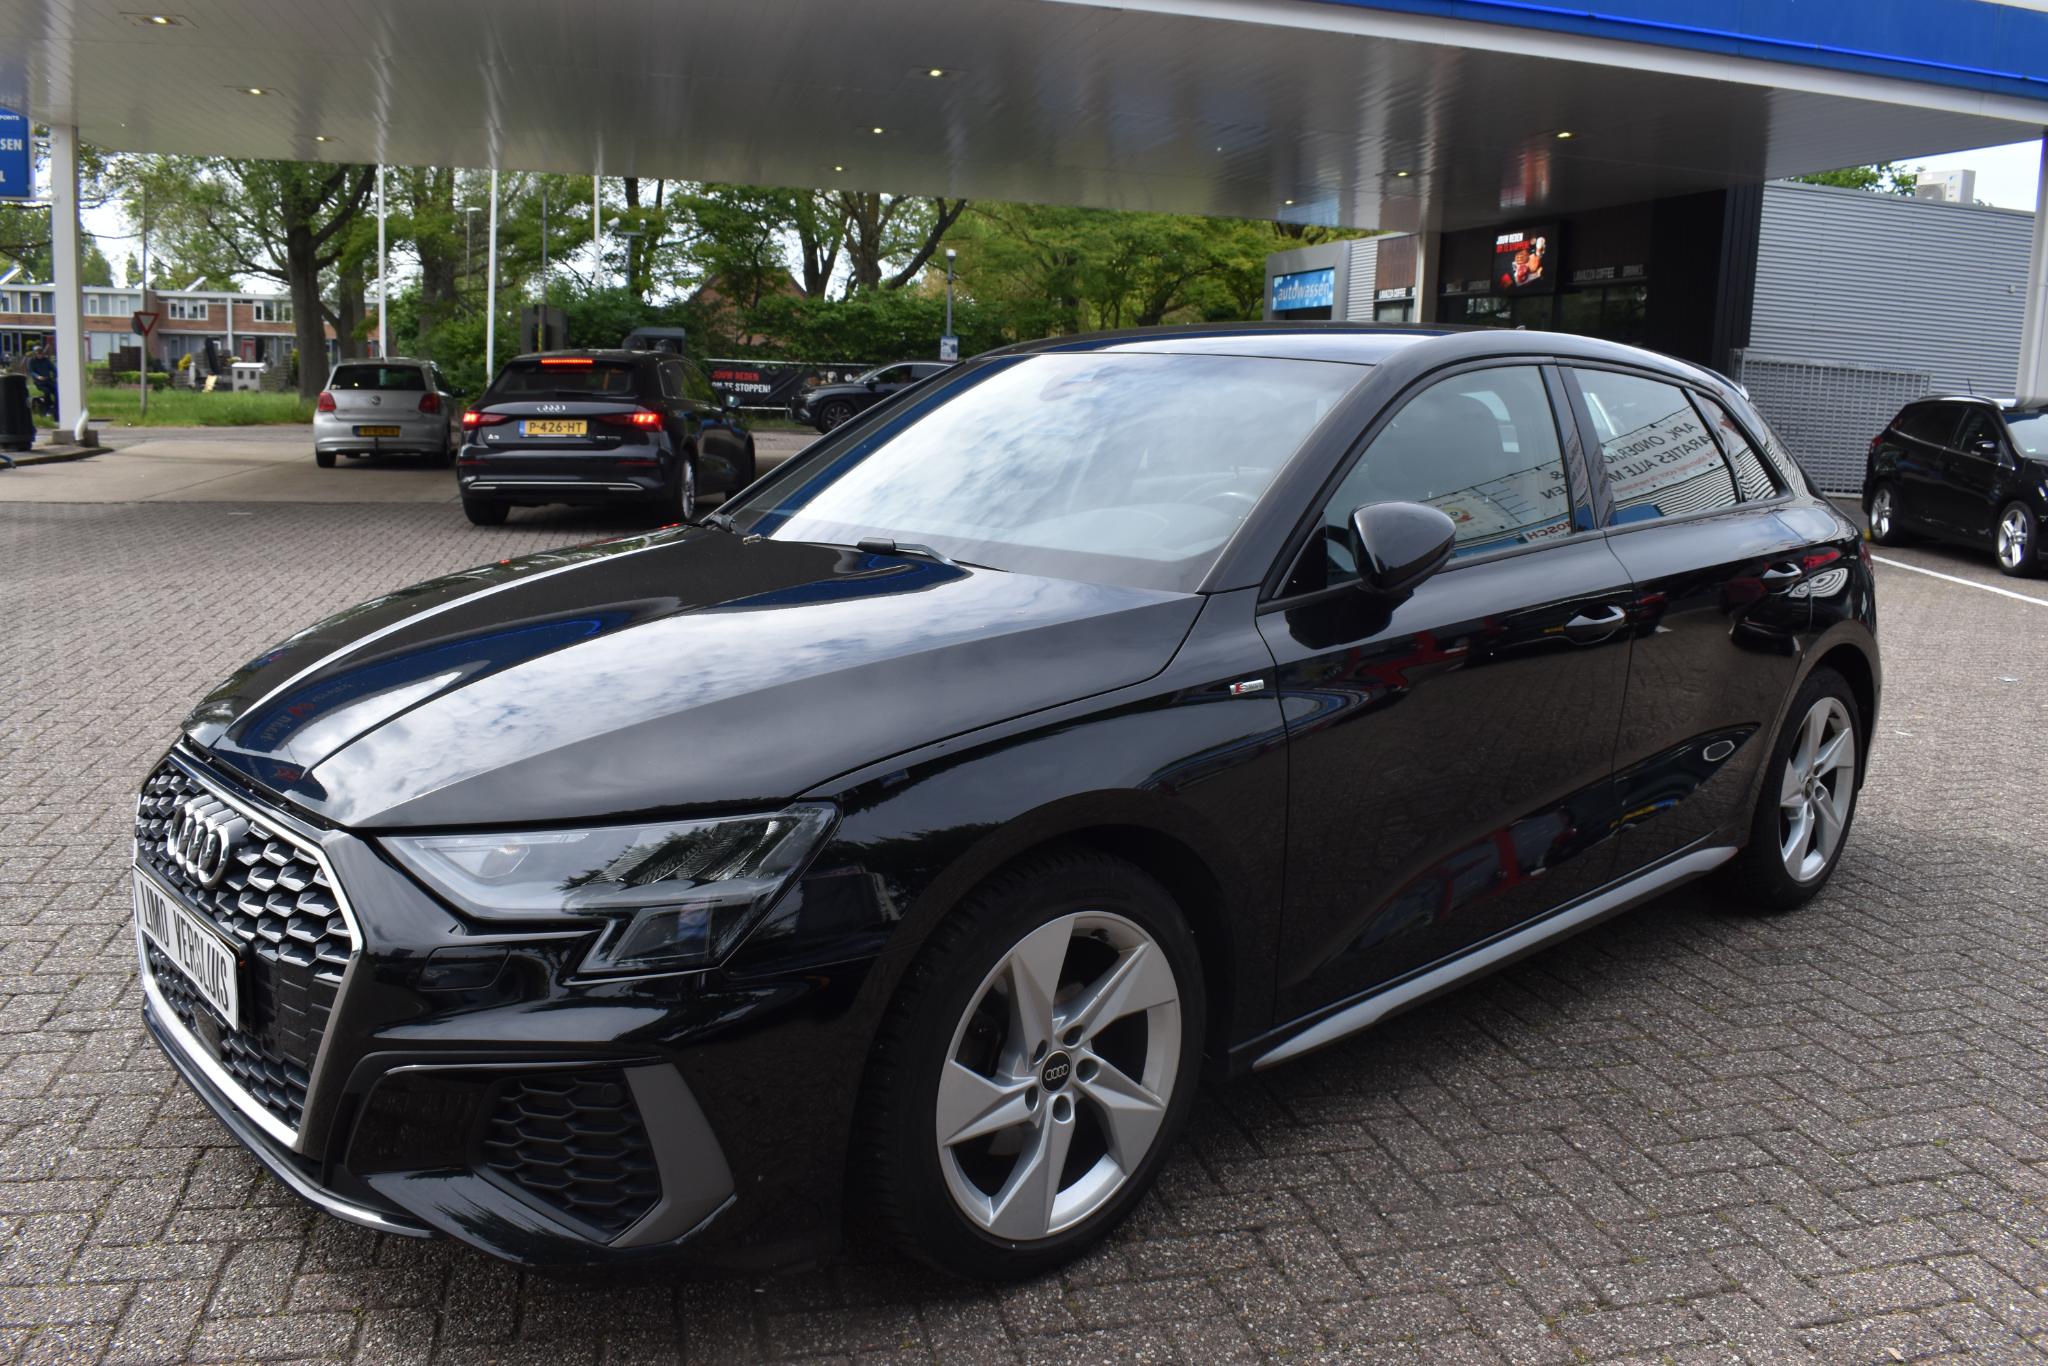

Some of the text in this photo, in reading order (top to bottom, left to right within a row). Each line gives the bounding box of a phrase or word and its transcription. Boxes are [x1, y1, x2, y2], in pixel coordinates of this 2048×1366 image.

[1278, 282, 1330, 300] autowassen
[735, 383, 771, 393] STOPPEN!
[529, 422, 583, 434] P-426-HT
[140, 880, 229, 1012] LIMO VERSLUIS
